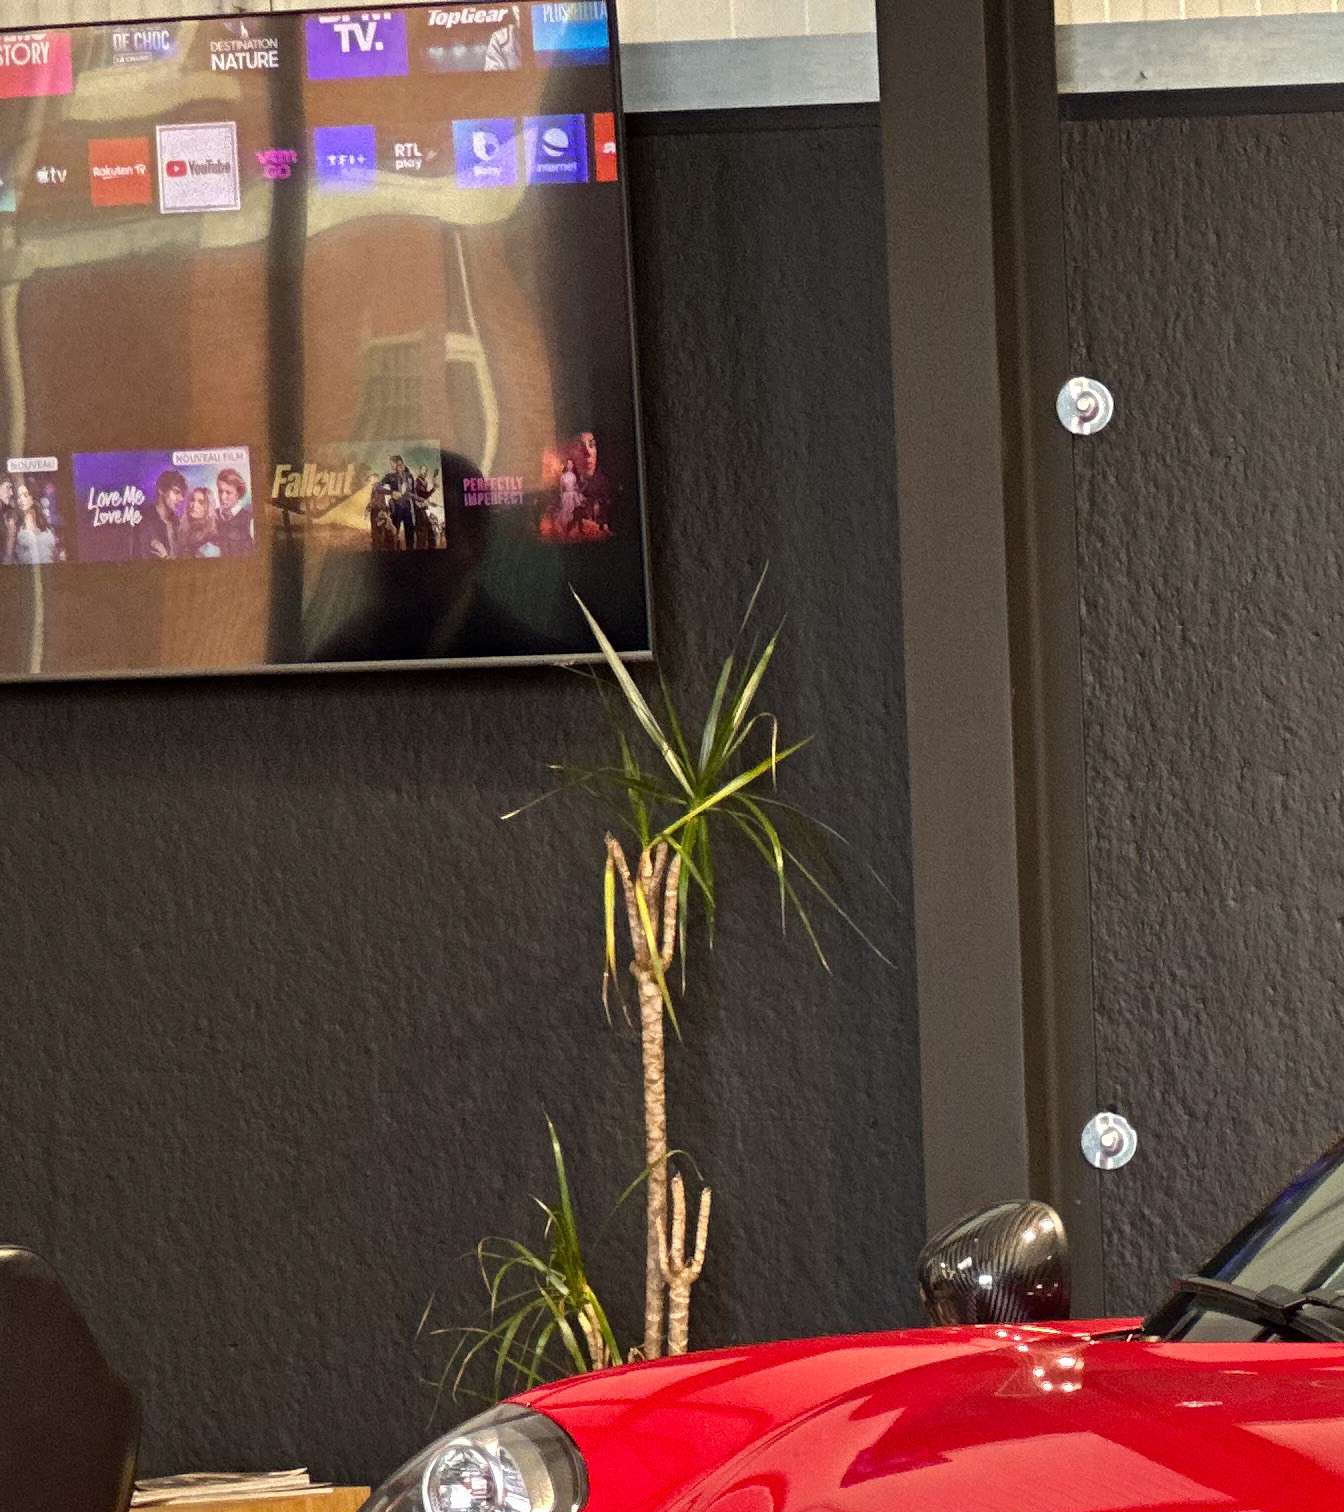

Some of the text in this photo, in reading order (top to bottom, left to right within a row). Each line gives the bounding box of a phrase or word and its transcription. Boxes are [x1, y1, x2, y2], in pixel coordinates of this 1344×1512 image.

[134, 30, 170, 50] CHOC
[209, 38, 279, 52] DESTINATION
[211, 50, 279, 70] NATURE
[394, 142, 423, 157] RTL
[92, 163, 147, 177] Rakuten TV
[188, 159, 231, 176] YouTube
[175, 453, 219, 464] NOUVEAU
[272, 463, 355, 498] Fallout
[88, 485, 145, 510] Love Me
[93, 506, 143, 527] Love Me
